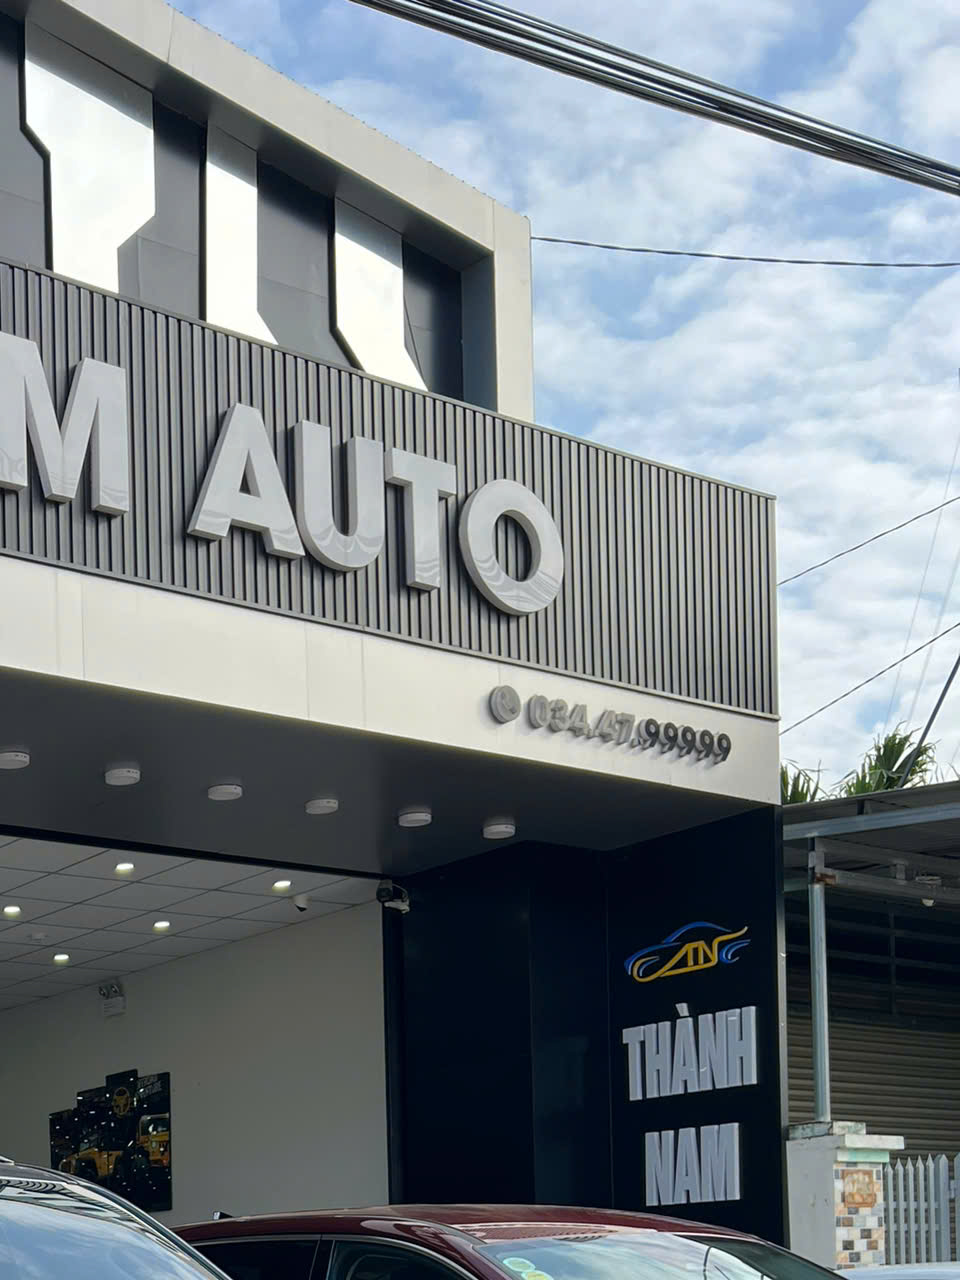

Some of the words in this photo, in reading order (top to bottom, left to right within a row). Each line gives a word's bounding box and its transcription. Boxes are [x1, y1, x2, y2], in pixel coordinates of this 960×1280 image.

[187, 402, 564, 616] AUTO
[622, 1003, 758, 1101] THÀNH
[645, 1122, 741, 1206] NAM
